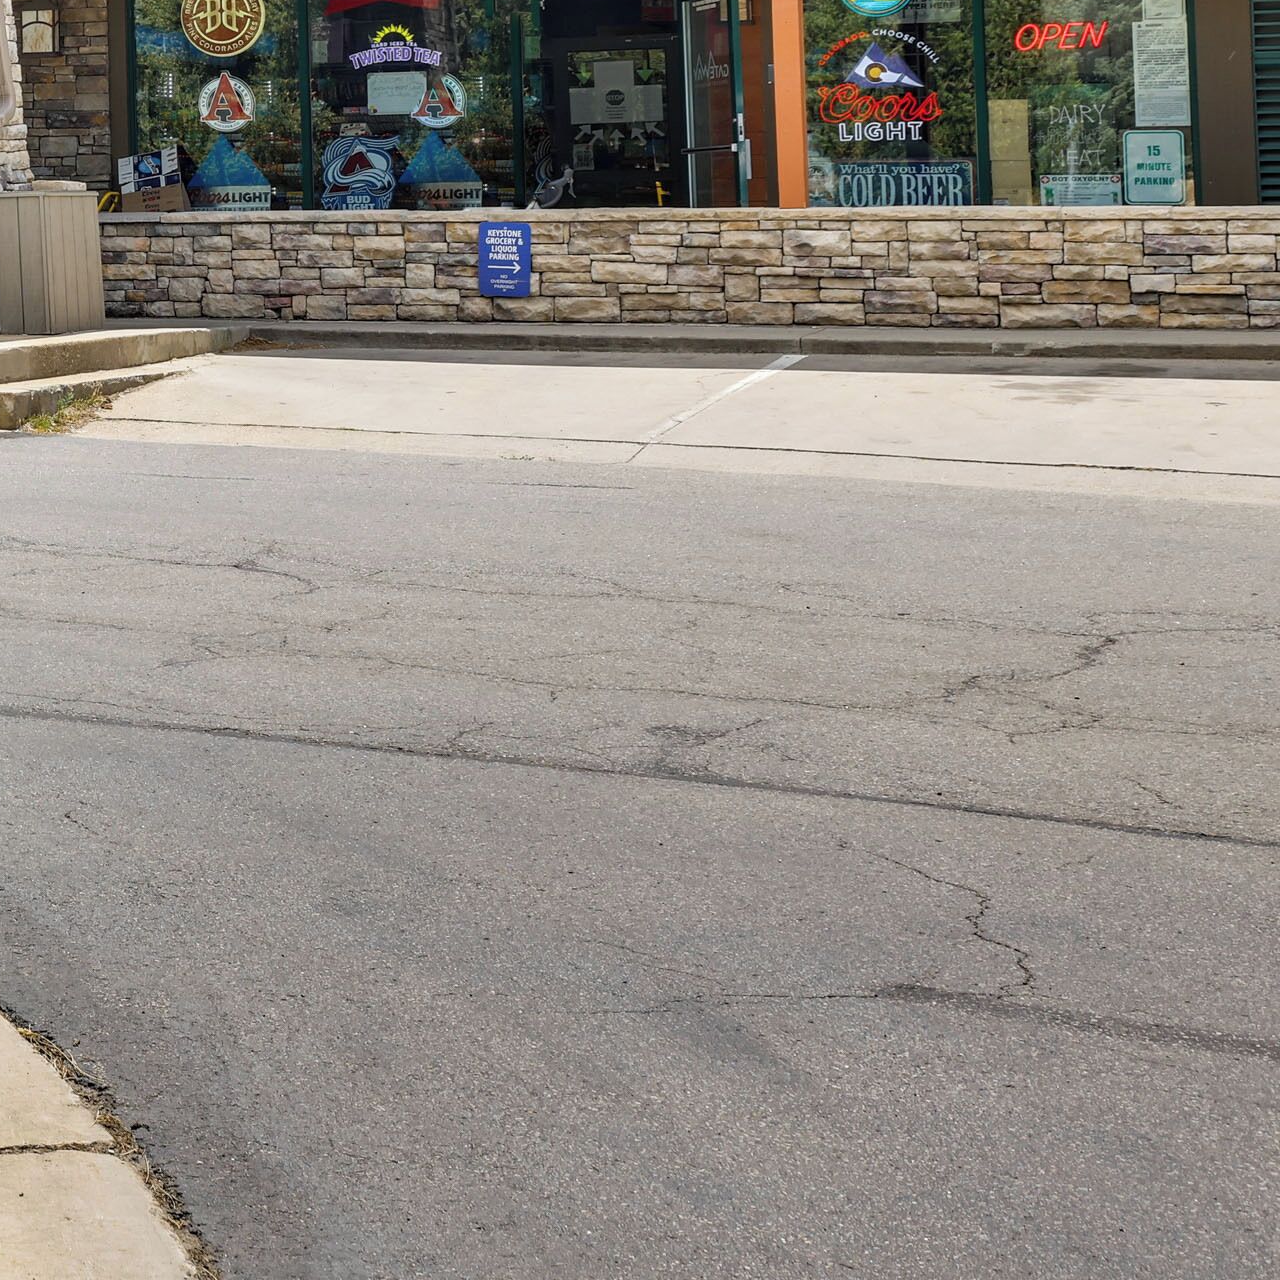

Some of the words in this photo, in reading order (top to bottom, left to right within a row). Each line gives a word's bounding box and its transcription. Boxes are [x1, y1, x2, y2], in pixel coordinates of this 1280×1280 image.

[186, 22, 200, 41] FINE
[198, 40, 244, 52] COLORADO
[245, 21, 258, 41] ALES
[1014, 21, 1109, 52] OPEN
[872, 28, 916, 44] CHOOSE
[916, 41, 940, 64] CHILL
[349, 46, 412, 70] TWISTED
[413, 47, 442, 67] TEA
[818, 82, 944, 123] Coors
[1049, 104, 1105, 124] DAIRY
[839, 121, 923, 141] LIGHT
[1147, 145, 1160, 156] 15
[1051, 149, 1106, 167] MEAT
[840, 164, 887, 174] What'll
[890, 166, 912, 176] you
[916, 164, 960, 174] have?
[1134, 177, 1175, 185] PARKING
[443, 188, 481, 199] LIGHT
[839, 174, 896, 206] COLD
[900, 174, 963, 206] BEER
[232, 192, 271, 203] LIGHT
[346, 195, 371, 204] BUD
[487, 229, 522, 238] KEYSTONE
[485, 237, 516, 245] GROCERY
[491, 245, 517, 254] LIQUOR
[488, 253, 520, 261] PARKING
